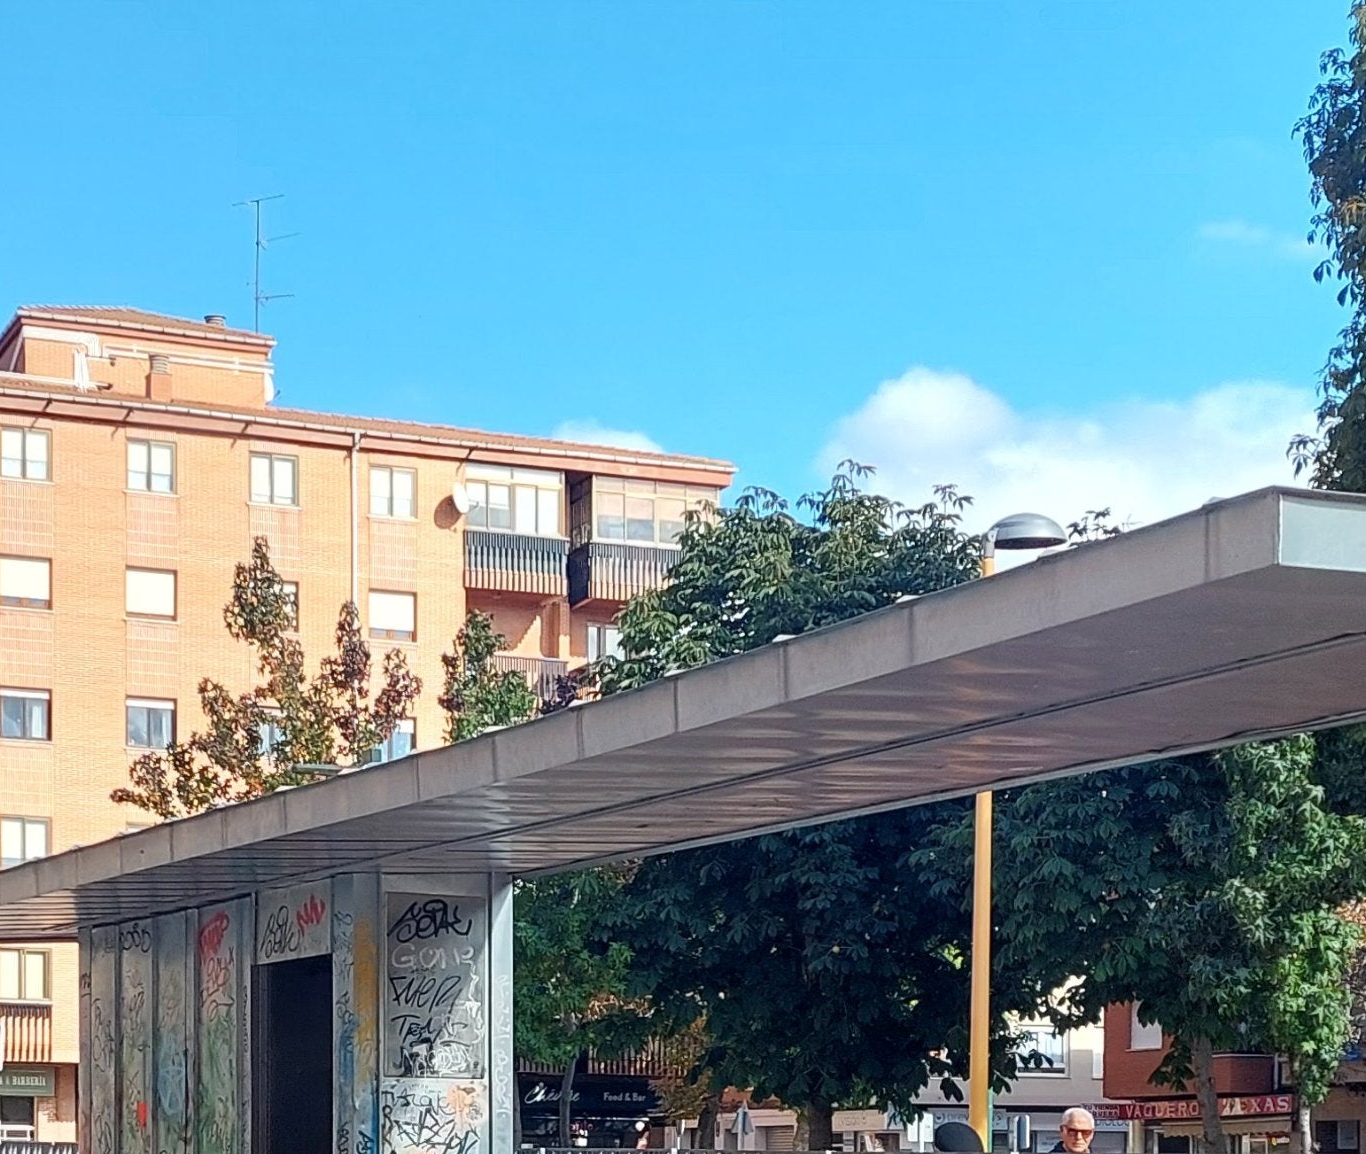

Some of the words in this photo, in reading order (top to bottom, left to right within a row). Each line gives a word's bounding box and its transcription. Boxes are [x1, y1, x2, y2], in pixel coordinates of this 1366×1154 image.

[603, 1091, 623, 1102] Food
[625, 1092, 631, 1102] &
[1222, 1097, 1290, 1116] TEXAS
